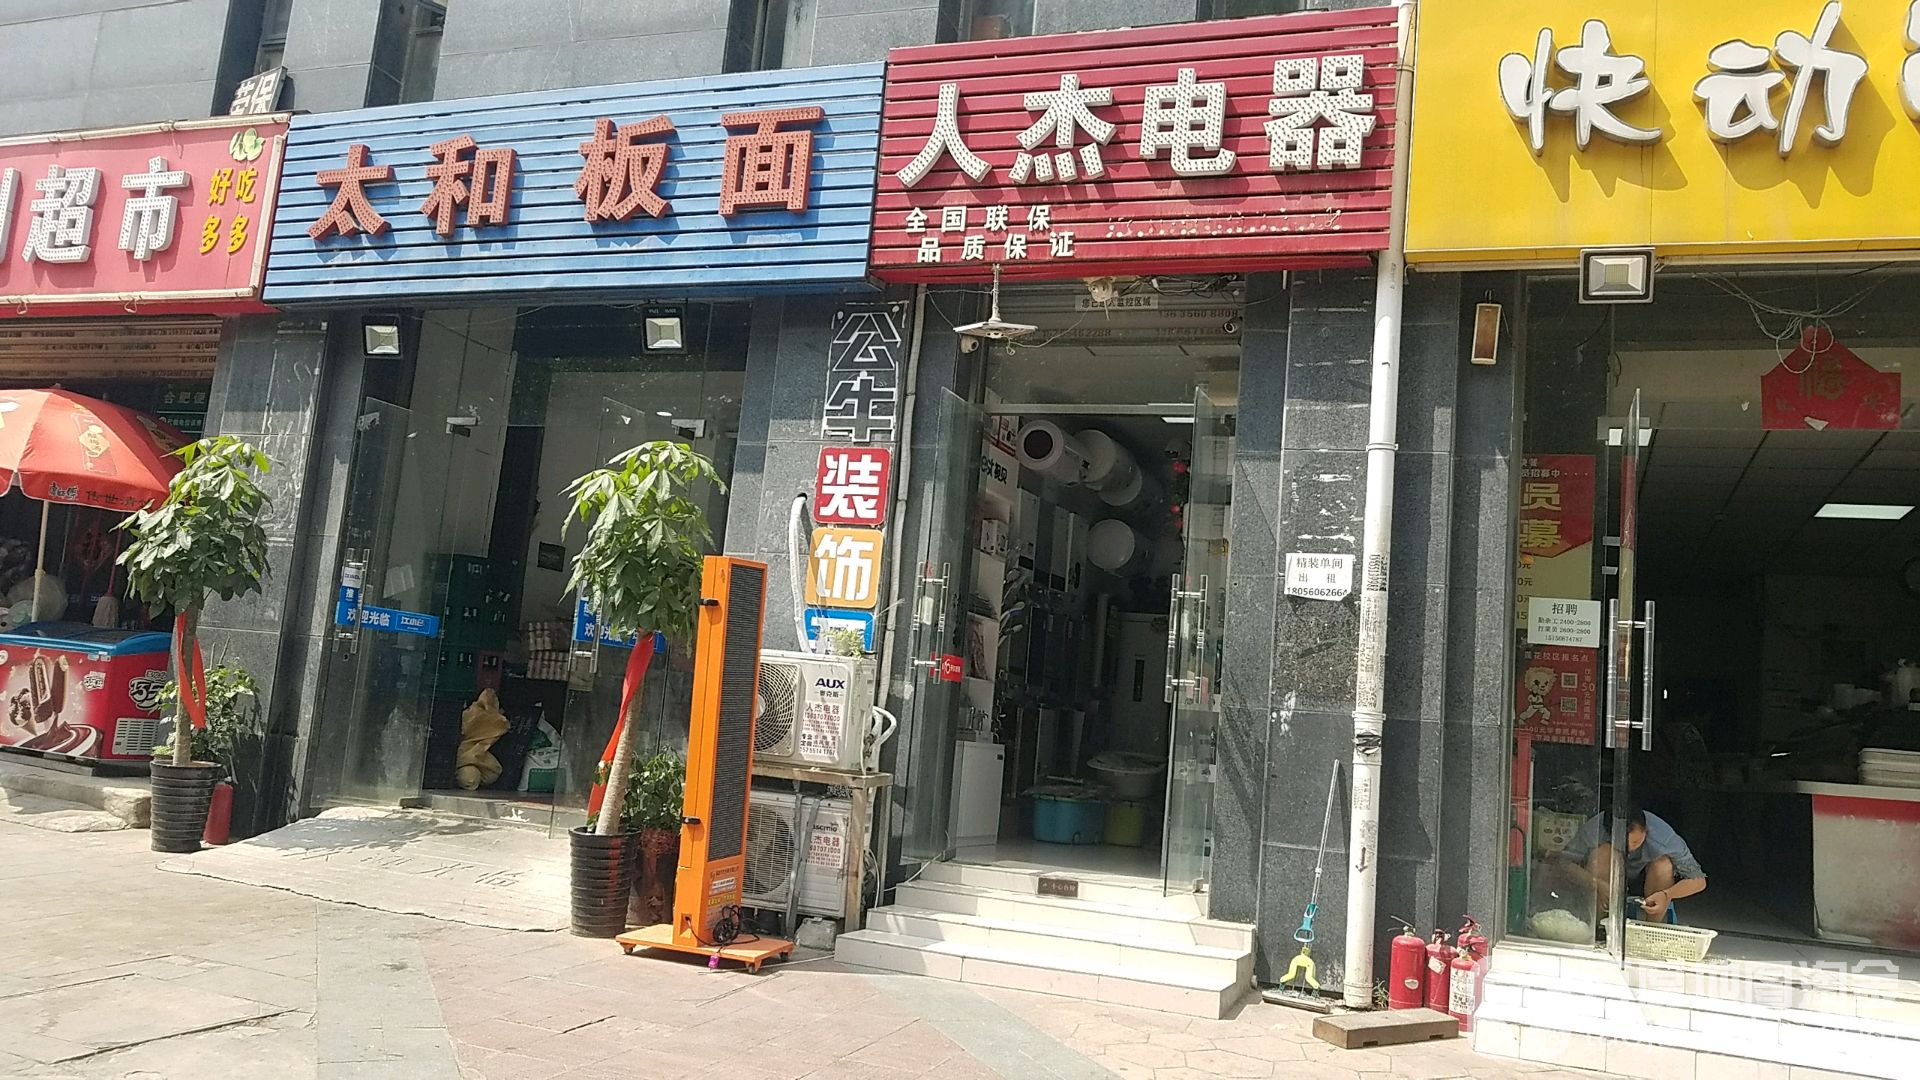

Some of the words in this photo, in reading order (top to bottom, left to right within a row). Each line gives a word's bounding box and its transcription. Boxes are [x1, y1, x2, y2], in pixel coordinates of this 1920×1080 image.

[1499, 0, 1920, 157] 快动
[895, 54, 1376, 188] 人杰电器
[207, 166, 258, 206] 好吃
[307, 106, 824, 241] 太和板面
[0, 156, 191, 263] 超市
[905, 205, 1050, 233] 全国联保
[198, 214, 250, 255] 多多
[917, 231, 1074, 263] 品质保证
[1296, 556, 1343, 568] 精装单间
[1551, 603, 1578, 616] 招聘
[815, 677, 846, 690] AUX
[810, 835, 840, 848] 杰电器
